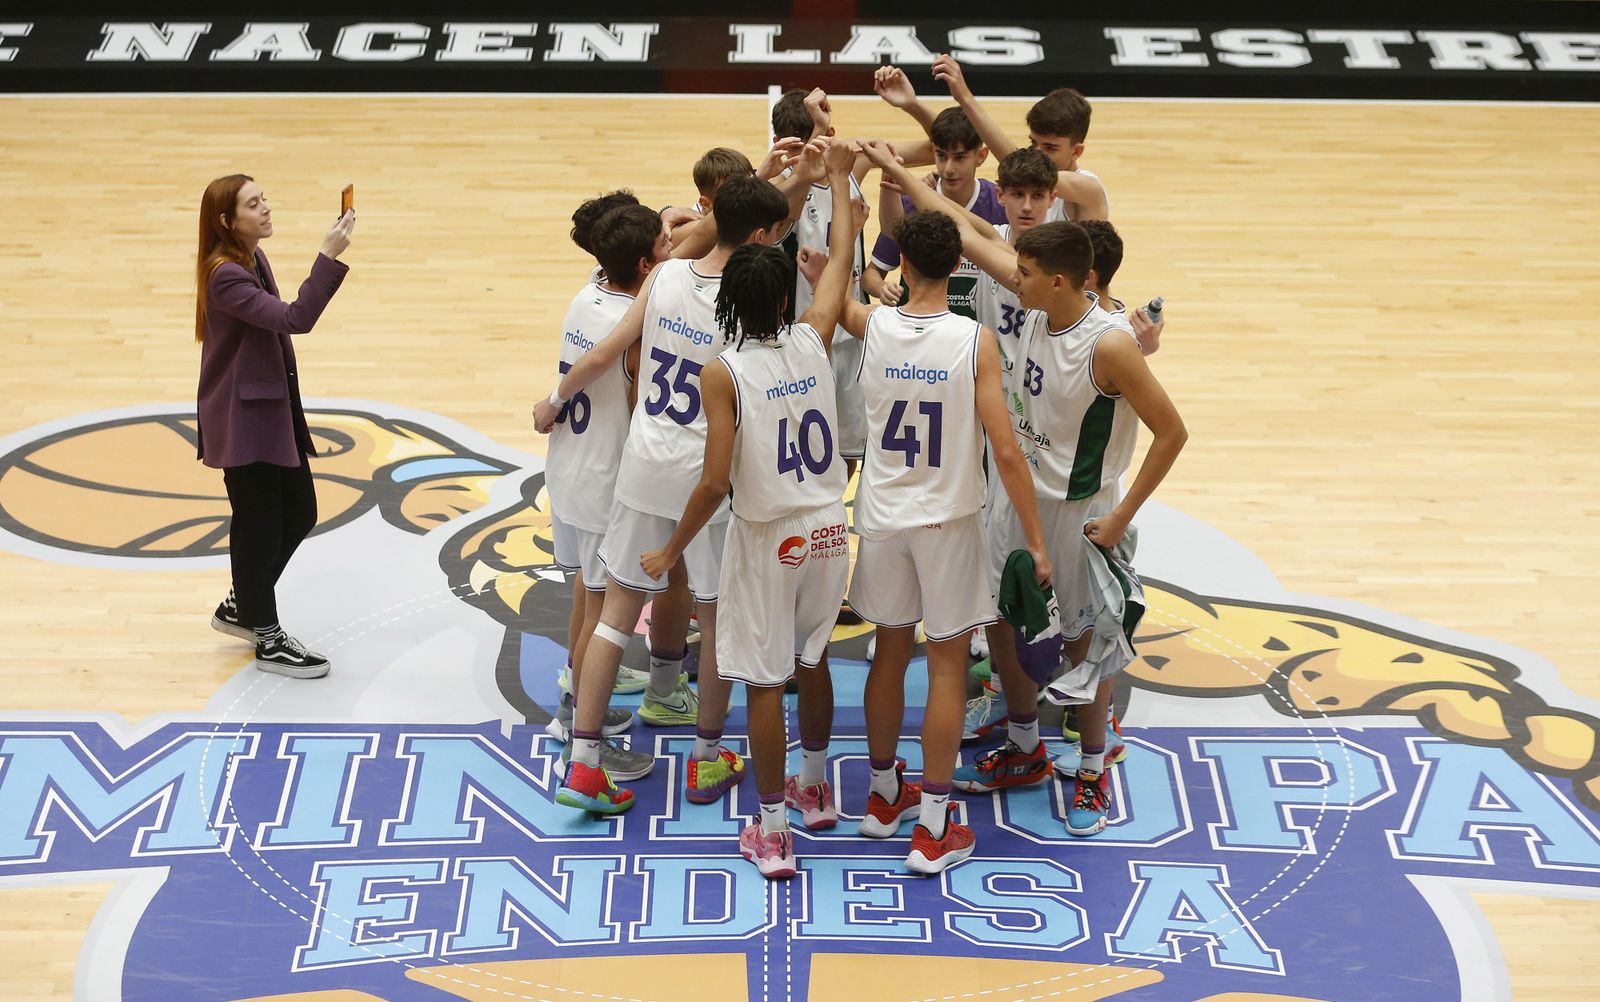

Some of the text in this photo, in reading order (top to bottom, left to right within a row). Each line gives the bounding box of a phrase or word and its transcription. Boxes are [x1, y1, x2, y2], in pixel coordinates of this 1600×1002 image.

[86, 22, 1600, 71] NACEN LAS ESTRE
[997, 303, 1025, 339] 38
[645, 346, 703, 425] 35
[777, 408, 833, 483] 40
[881, 400, 942, 468] 41
[811, 523, 847, 541] COSTA
[811, 536, 847, 552] DEL SOL
[0, 731, 758, 866] MINI
[291, 853, 1286, 976] ENDESA
